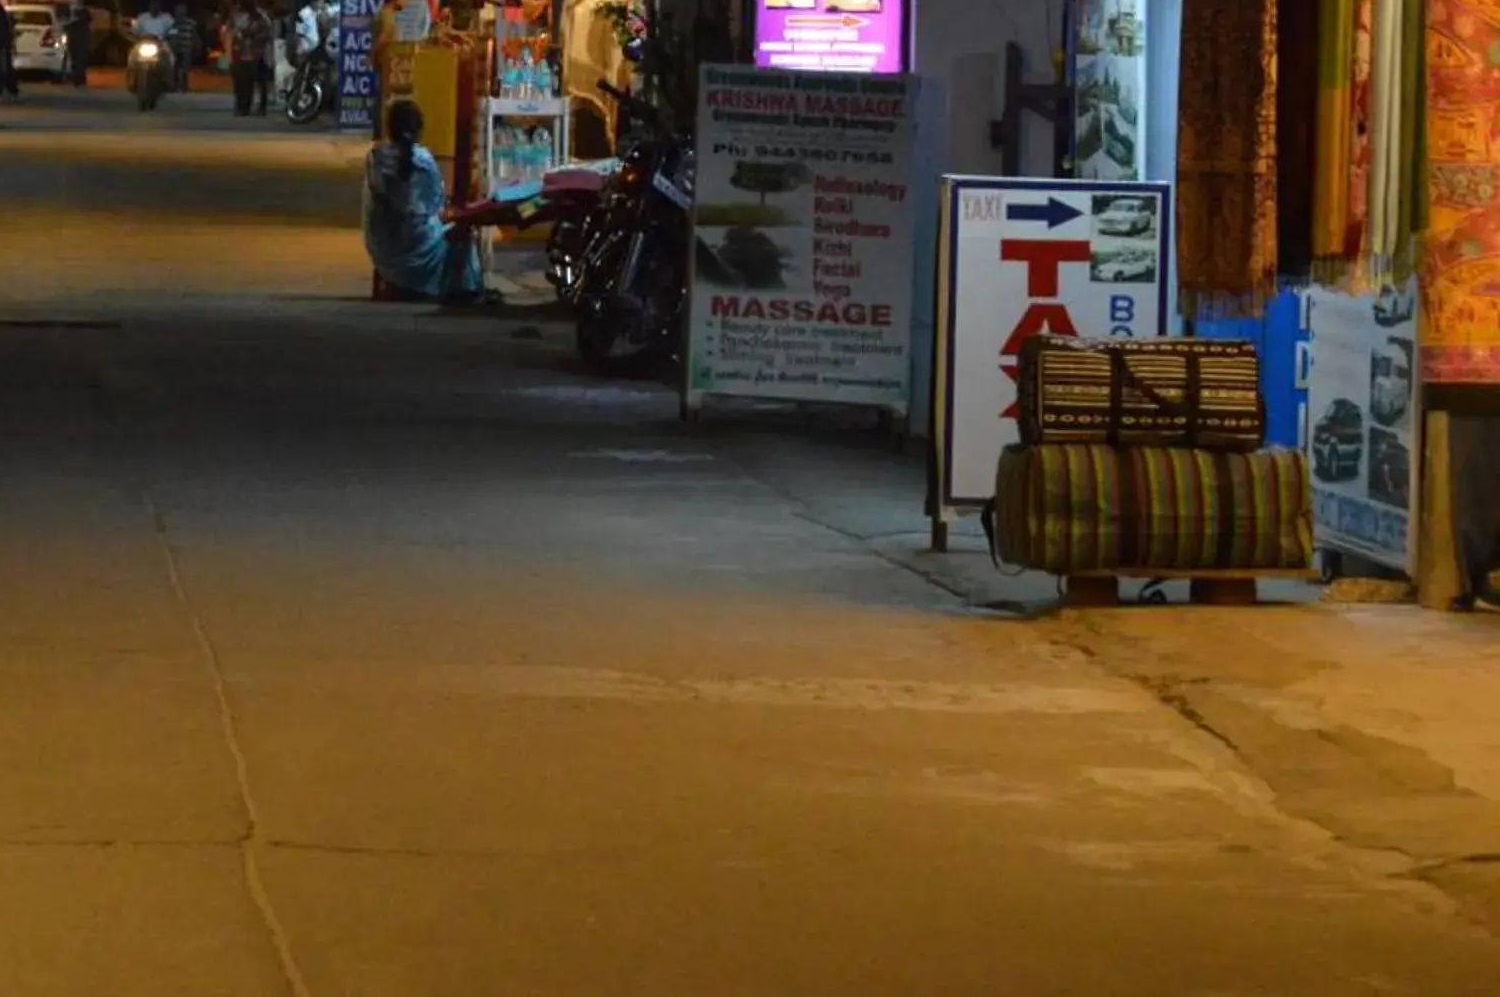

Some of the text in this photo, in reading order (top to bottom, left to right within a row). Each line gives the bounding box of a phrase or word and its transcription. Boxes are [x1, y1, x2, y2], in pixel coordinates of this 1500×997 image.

[806, 96, 904, 117] MASSAGE
[963, 193, 1000, 221] TAXI
[711, 296, 892, 326] MASSAGE
